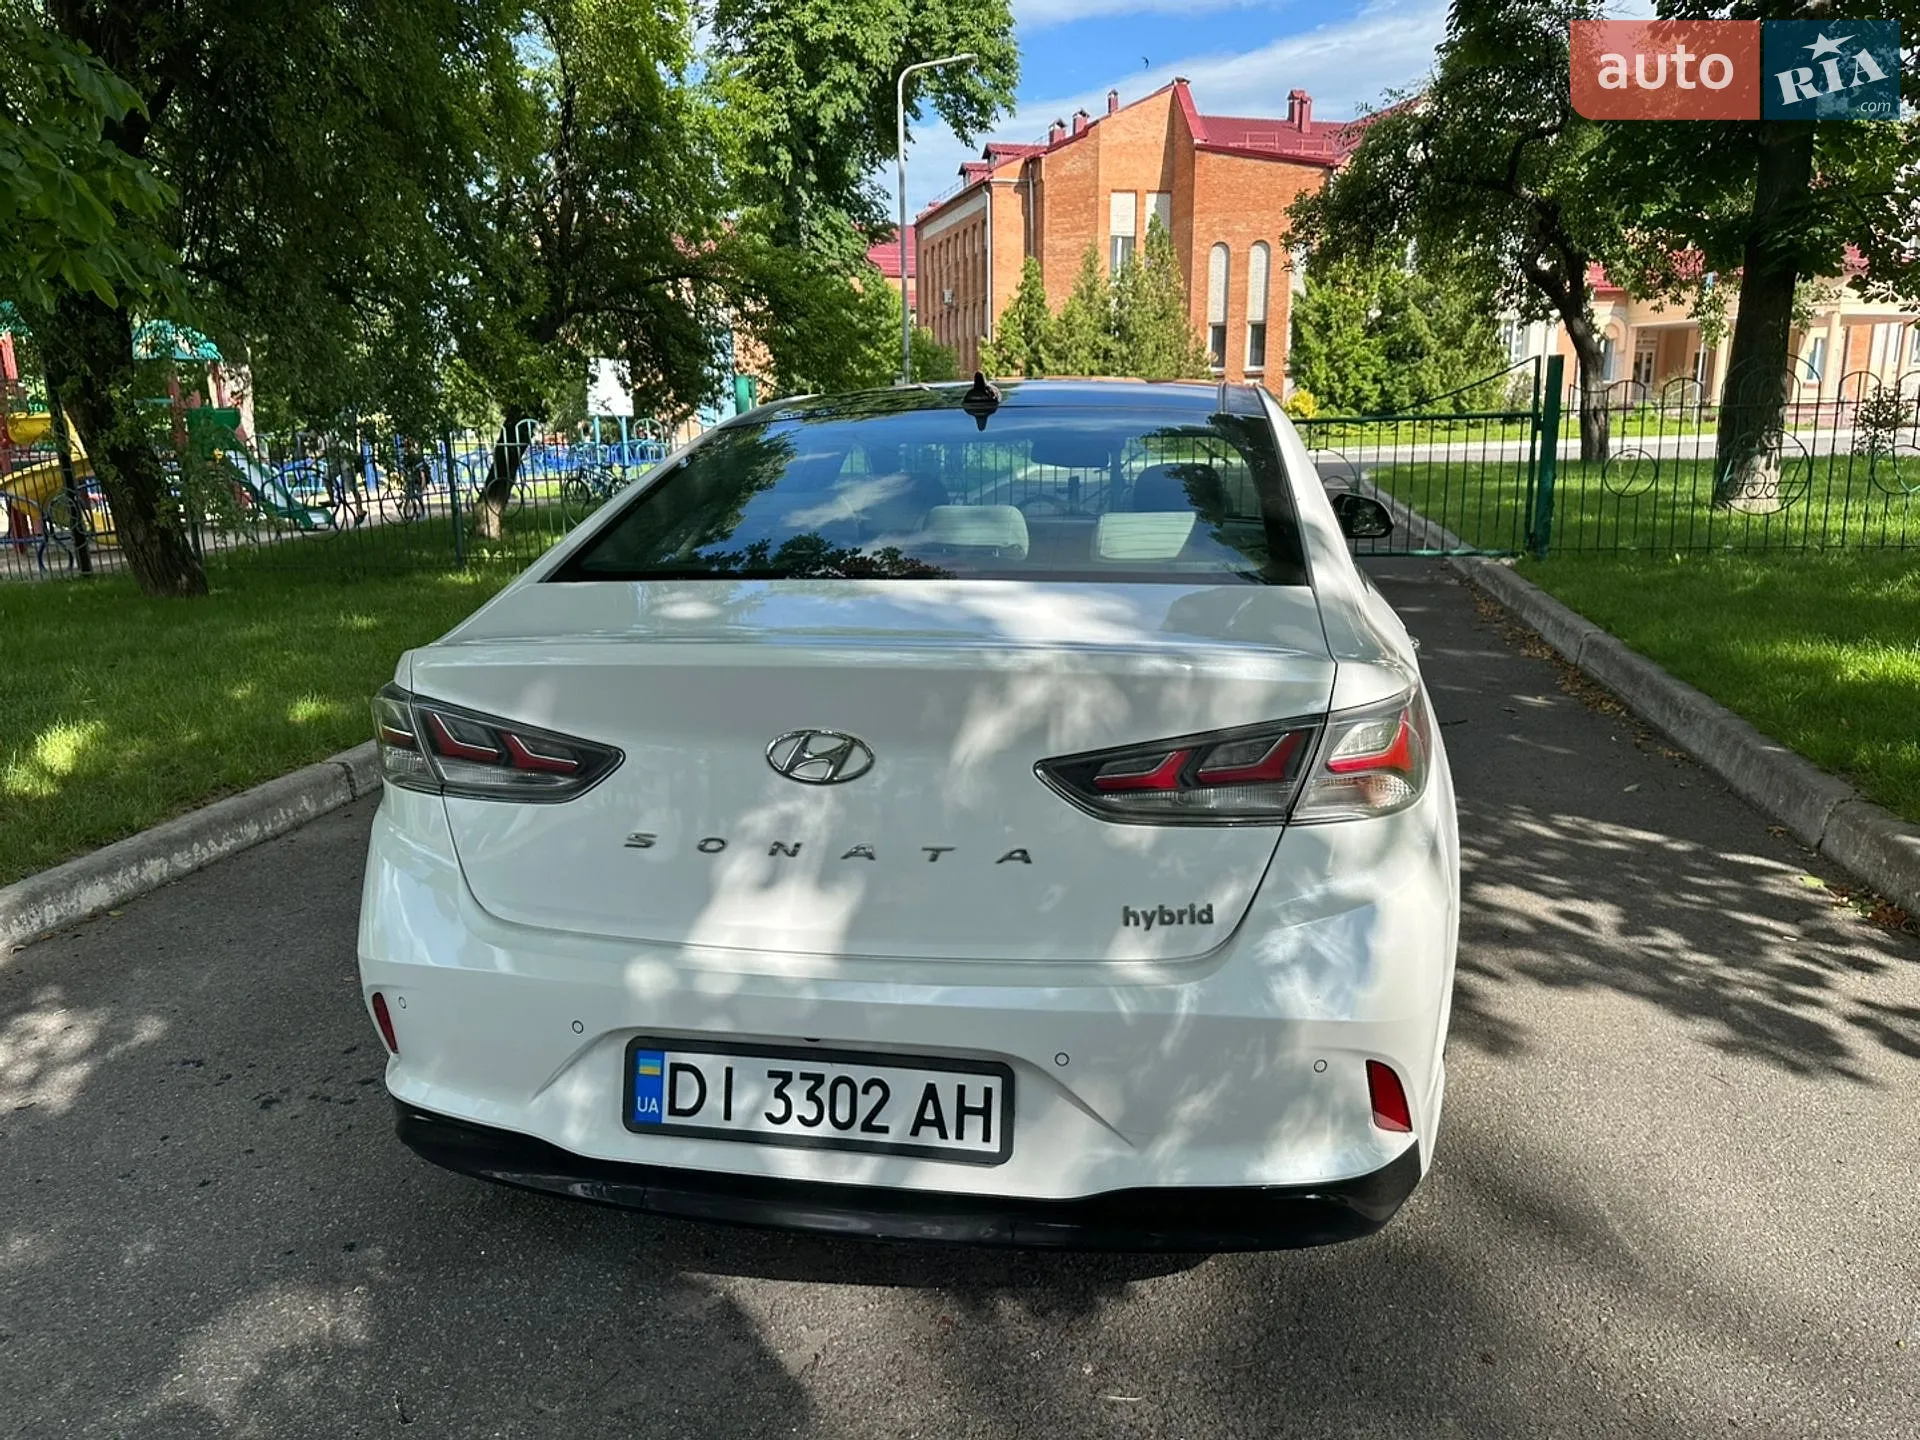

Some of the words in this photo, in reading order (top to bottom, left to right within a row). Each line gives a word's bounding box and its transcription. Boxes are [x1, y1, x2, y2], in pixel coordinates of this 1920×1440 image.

[624, 832, 1032, 864] SONATA
[1122, 903, 1214, 930] hybrid
[636, 1097, 660, 1114] UA
[667, 1062, 734, 1122] DI
[764, 1069, 891, 1134] 3302
[909, 1083, 993, 1143] AH
